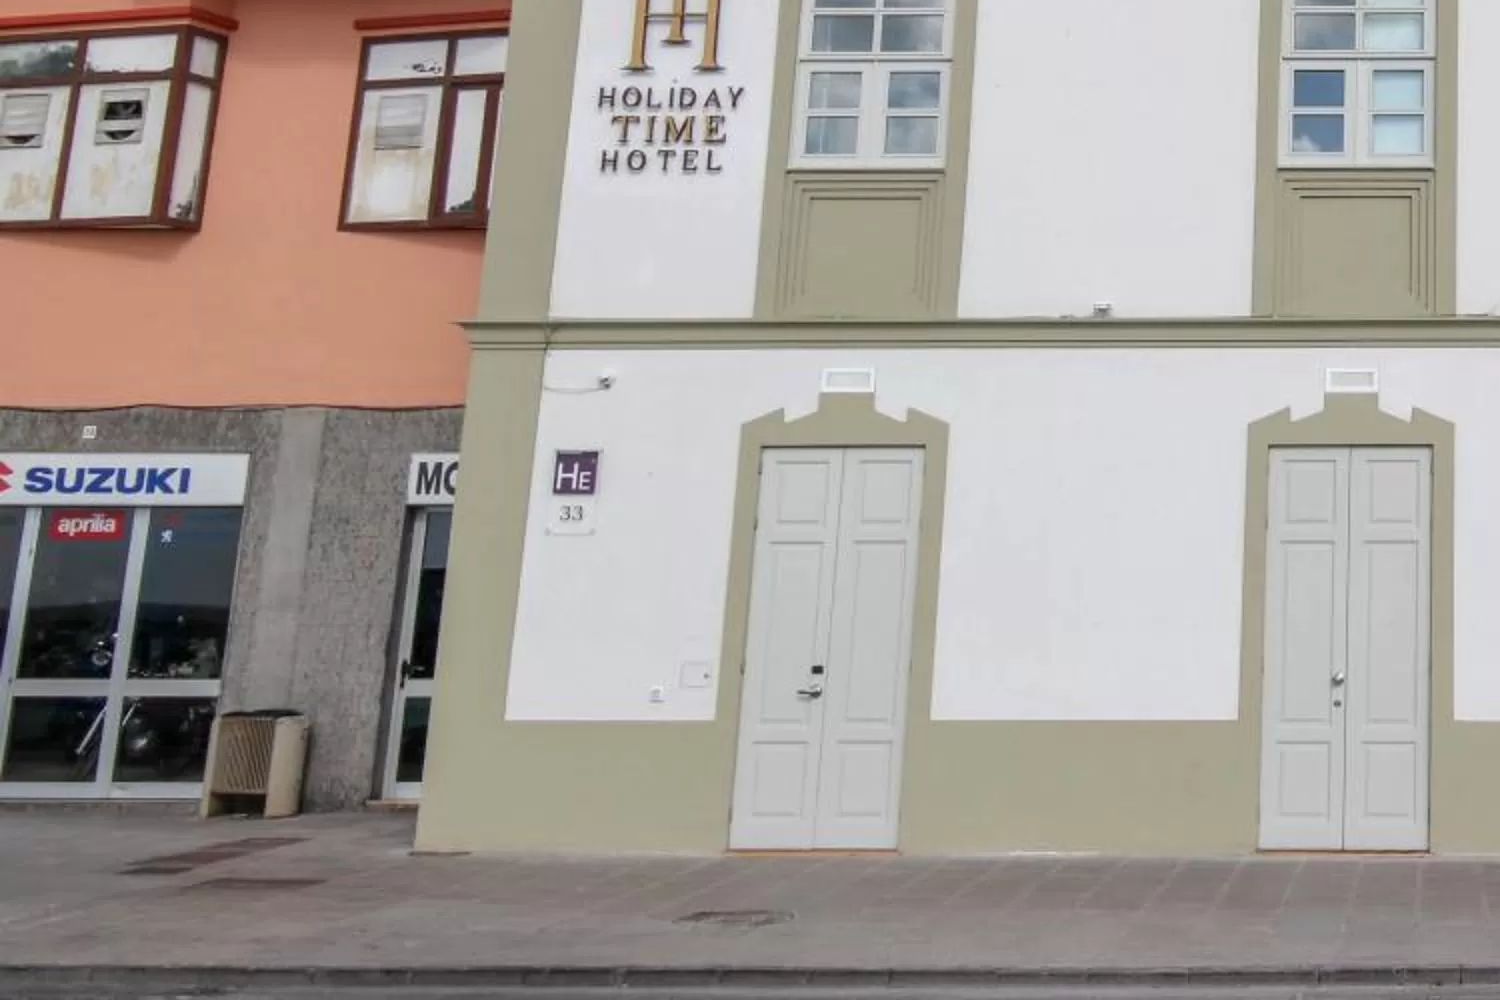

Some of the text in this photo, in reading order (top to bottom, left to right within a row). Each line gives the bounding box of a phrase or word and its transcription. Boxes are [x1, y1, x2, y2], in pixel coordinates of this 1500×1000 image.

[597, 86, 745, 110] HOLIDAY
[611, 115, 727, 145] TIME
[600, 149, 723, 173] HOTEL
[24, 466, 191, 494] SUZUKI
[58, 513, 117, 536] aprilia
